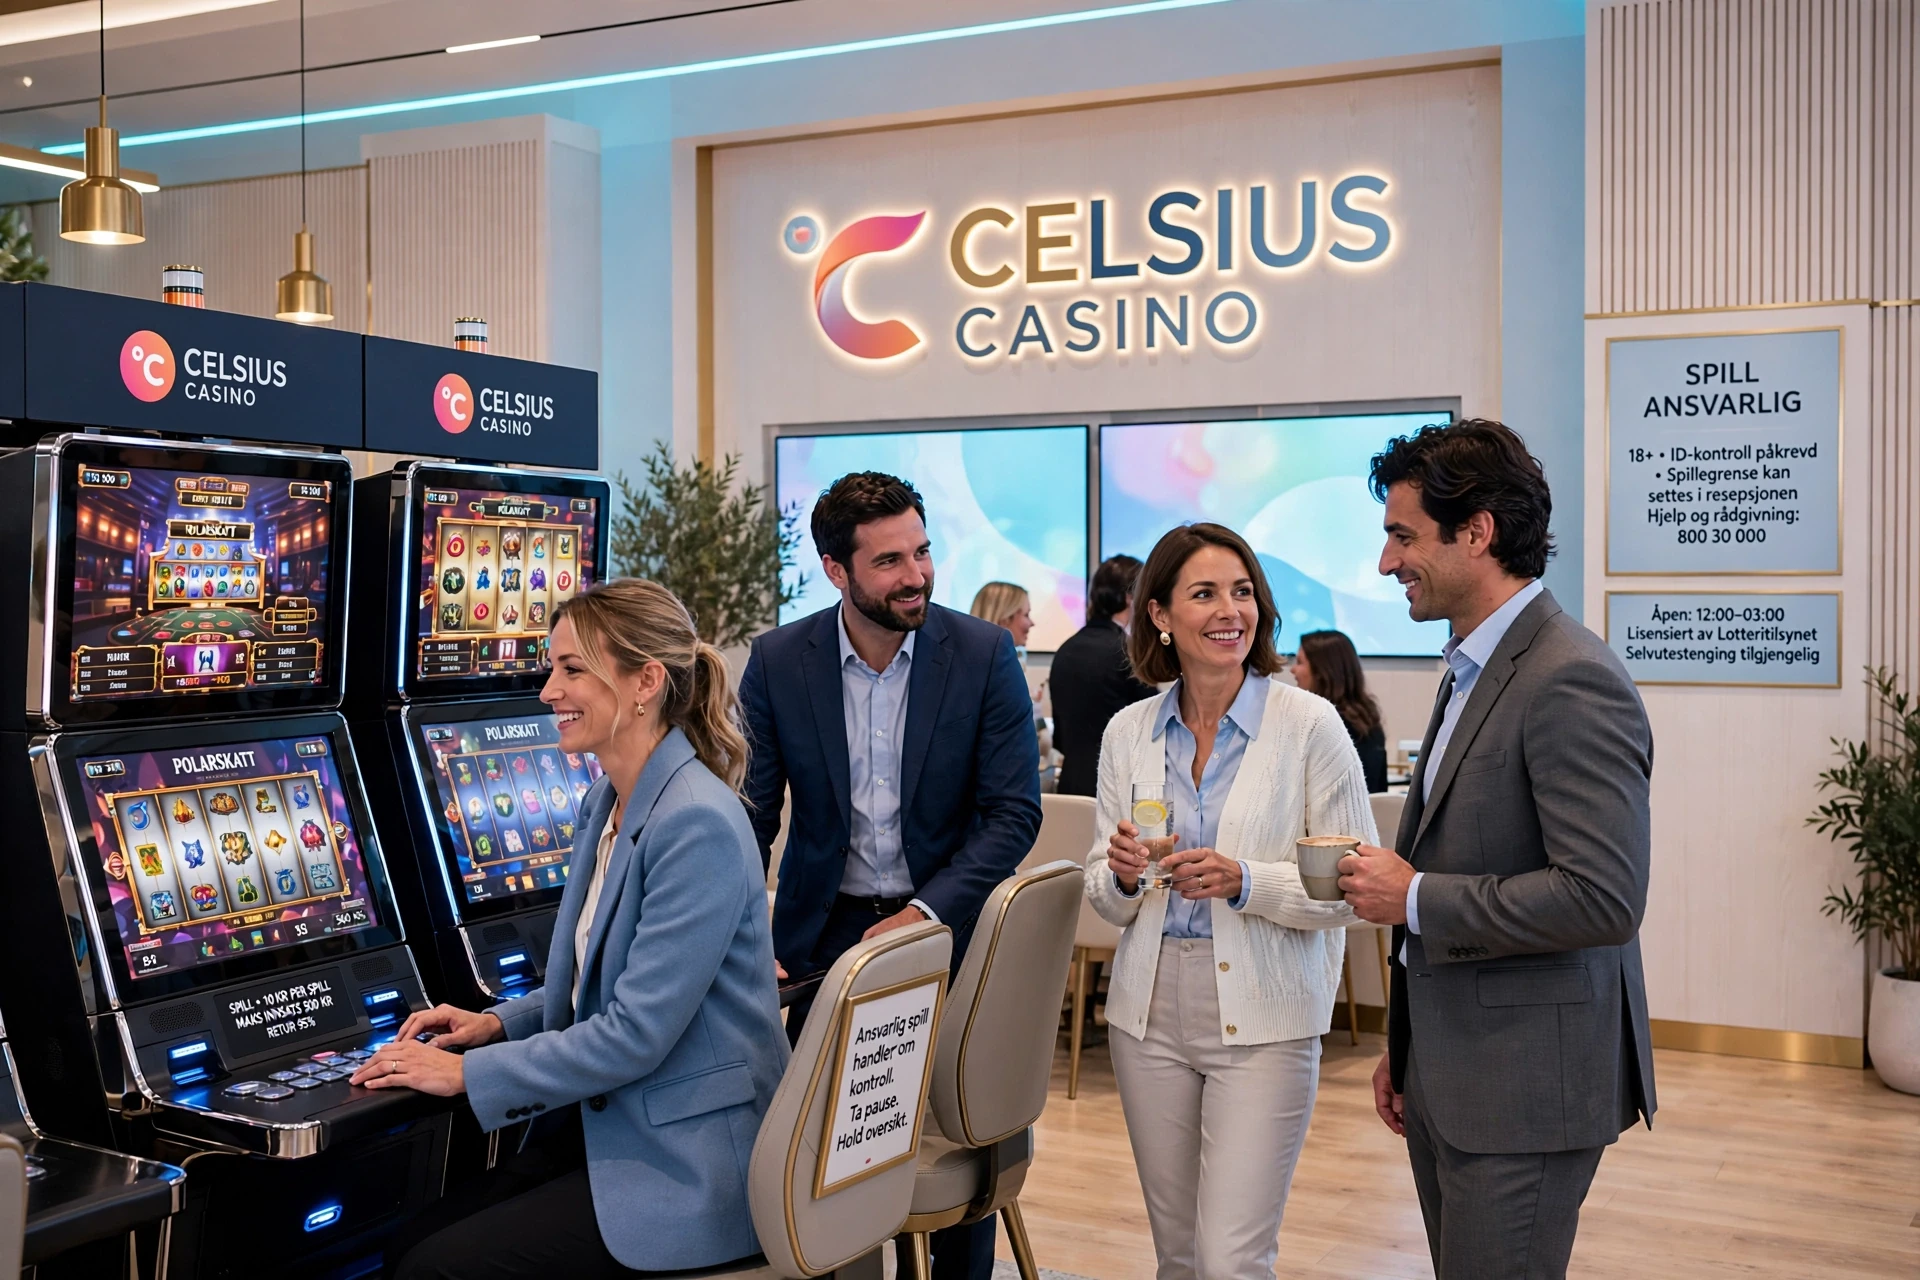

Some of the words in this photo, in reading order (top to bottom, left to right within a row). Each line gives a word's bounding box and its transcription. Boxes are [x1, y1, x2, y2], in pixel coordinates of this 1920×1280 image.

[950, 175, 1391, 289] CELSIUS
[956, 290, 1257, 357] CASINO
[184, 349, 286, 389] CELSIUS
[1686, 362, 1759, 385] SPILL
[186, 381, 255, 405] CASINO
[480, 388, 553, 421] CELSIUS
[1644, 391, 1800, 417] ANSVARLIG
[480, 417, 531, 435] CASINO
[1629, 448, 1653, 462] 18+
[1672, 445, 1751, 461] ID-kontroll
[1757, 443, 1817, 463] påkrevd
[1668, 467, 1758, 487] Spillegrense
[1764, 465, 1790, 479] kan
[1649, 490, 1693, 502] settes
[1707, 486, 1797, 504] resepsjonen
[1649, 508, 1686, 526] Hjelp
[1691, 512, 1709, 525] og
[1714, 506, 1799, 525] rådgivning:
[1678, 529, 1707, 543] 800
[1712, 529, 1731, 543] 30
[1736, 529, 1766, 543] 000
[1652, 604, 1691, 624] Åpen:
[1628, 626, 1693, 640] Lisensiert
[1698, 630, 1713, 640] av
[1718, 627, 1817, 645] Lotteritilsynet
[1626, 646, 1736, 663] Selvutestenging
[1741, 646, 1819, 664] tilgjengelig
[485, 723, 540, 741] POLARSKATT
[172, 751, 256, 774] POLARSKATT
[229, 999, 255, 1014] SPILL
[263, 994, 274, 1006] 10
[276, 991, 288, 1003] KR
[290, 986, 307, 1000] PER
[308, 980, 331, 995] SPILL
[236, 1012, 263, 1029] MAKS
[321, 996, 333, 1007] KR
[267, 1022, 296, 1038] RETUR
[855, 1016, 905, 1045] Ansvarlig
[908, 1008, 929, 1032] spill
[853, 1046, 897, 1071] handler
[899, 1040, 915, 1055] om
[850, 1068, 894, 1097] kontroll.
[850, 1104, 863, 1122] Ta
[864, 1096, 899, 1122] pause.
[837, 1129, 863, 1151] Hold
[865, 1112, 907, 1140] oversikt.
